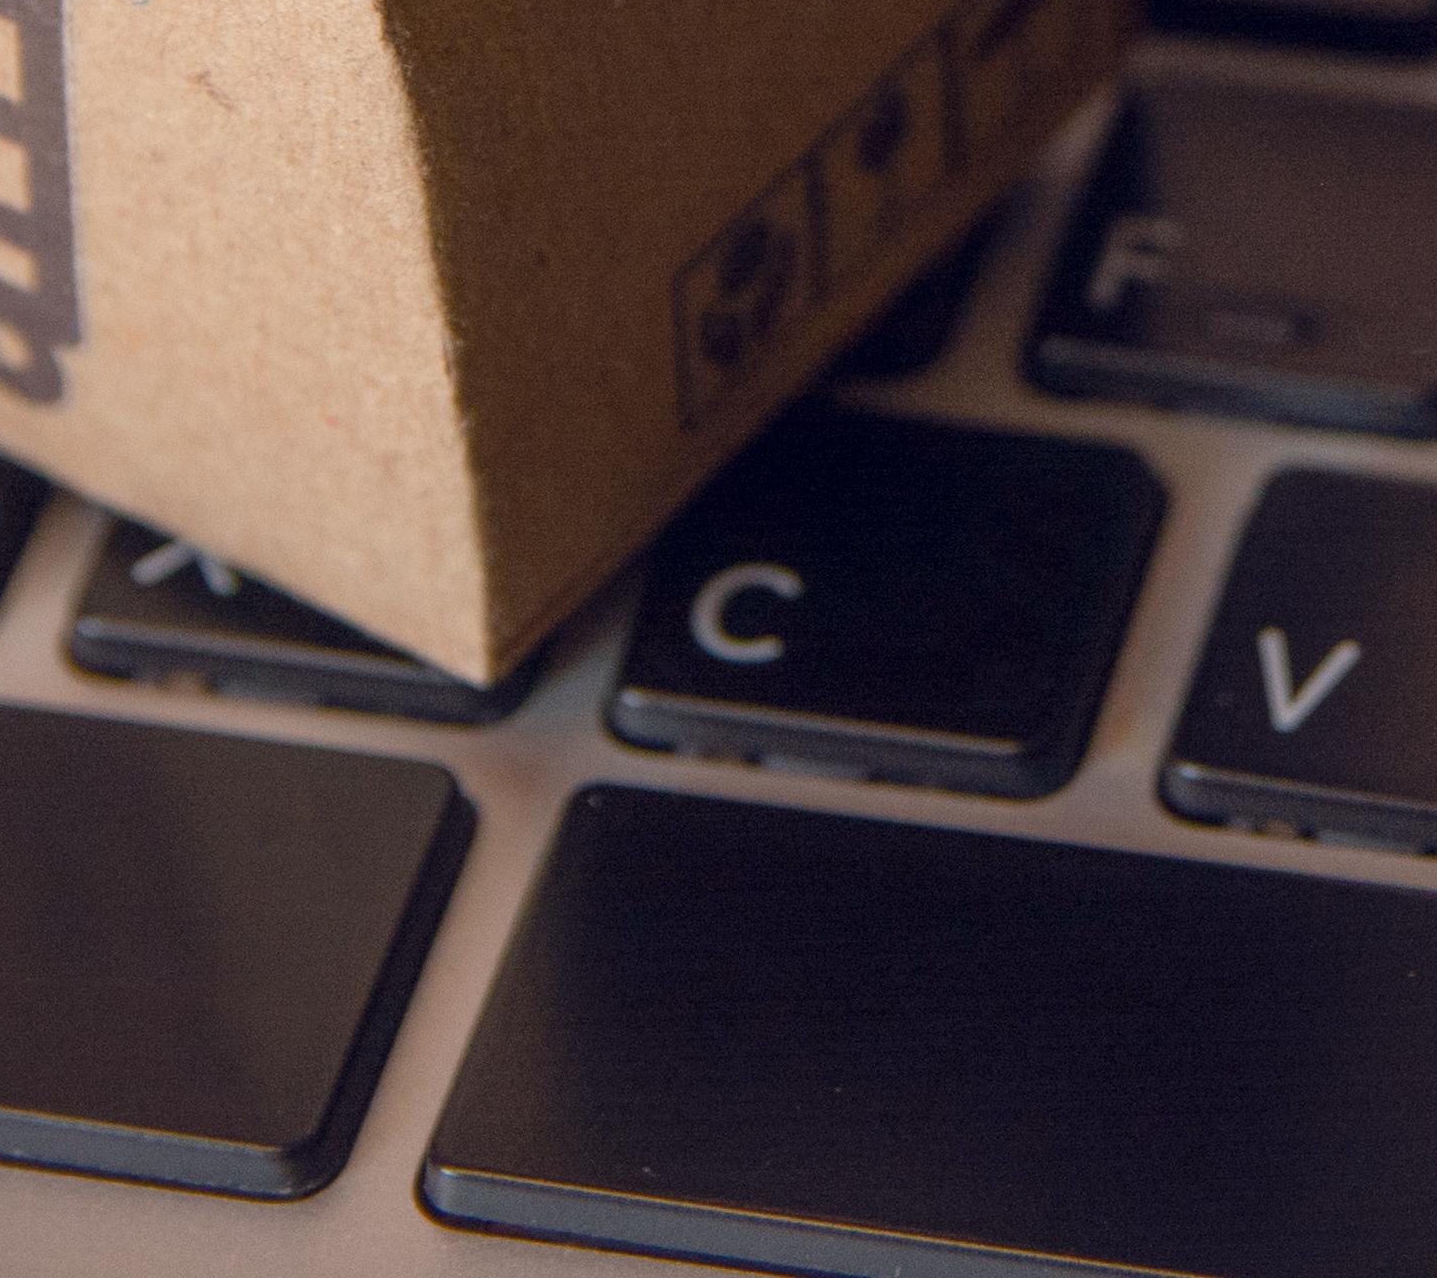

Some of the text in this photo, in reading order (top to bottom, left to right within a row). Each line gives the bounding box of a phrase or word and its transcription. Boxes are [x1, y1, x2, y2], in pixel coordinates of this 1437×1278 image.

[1087, 217, 1183, 311] F
[689, 561, 805, 665] C
[1256, 627, 1362, 733] V
